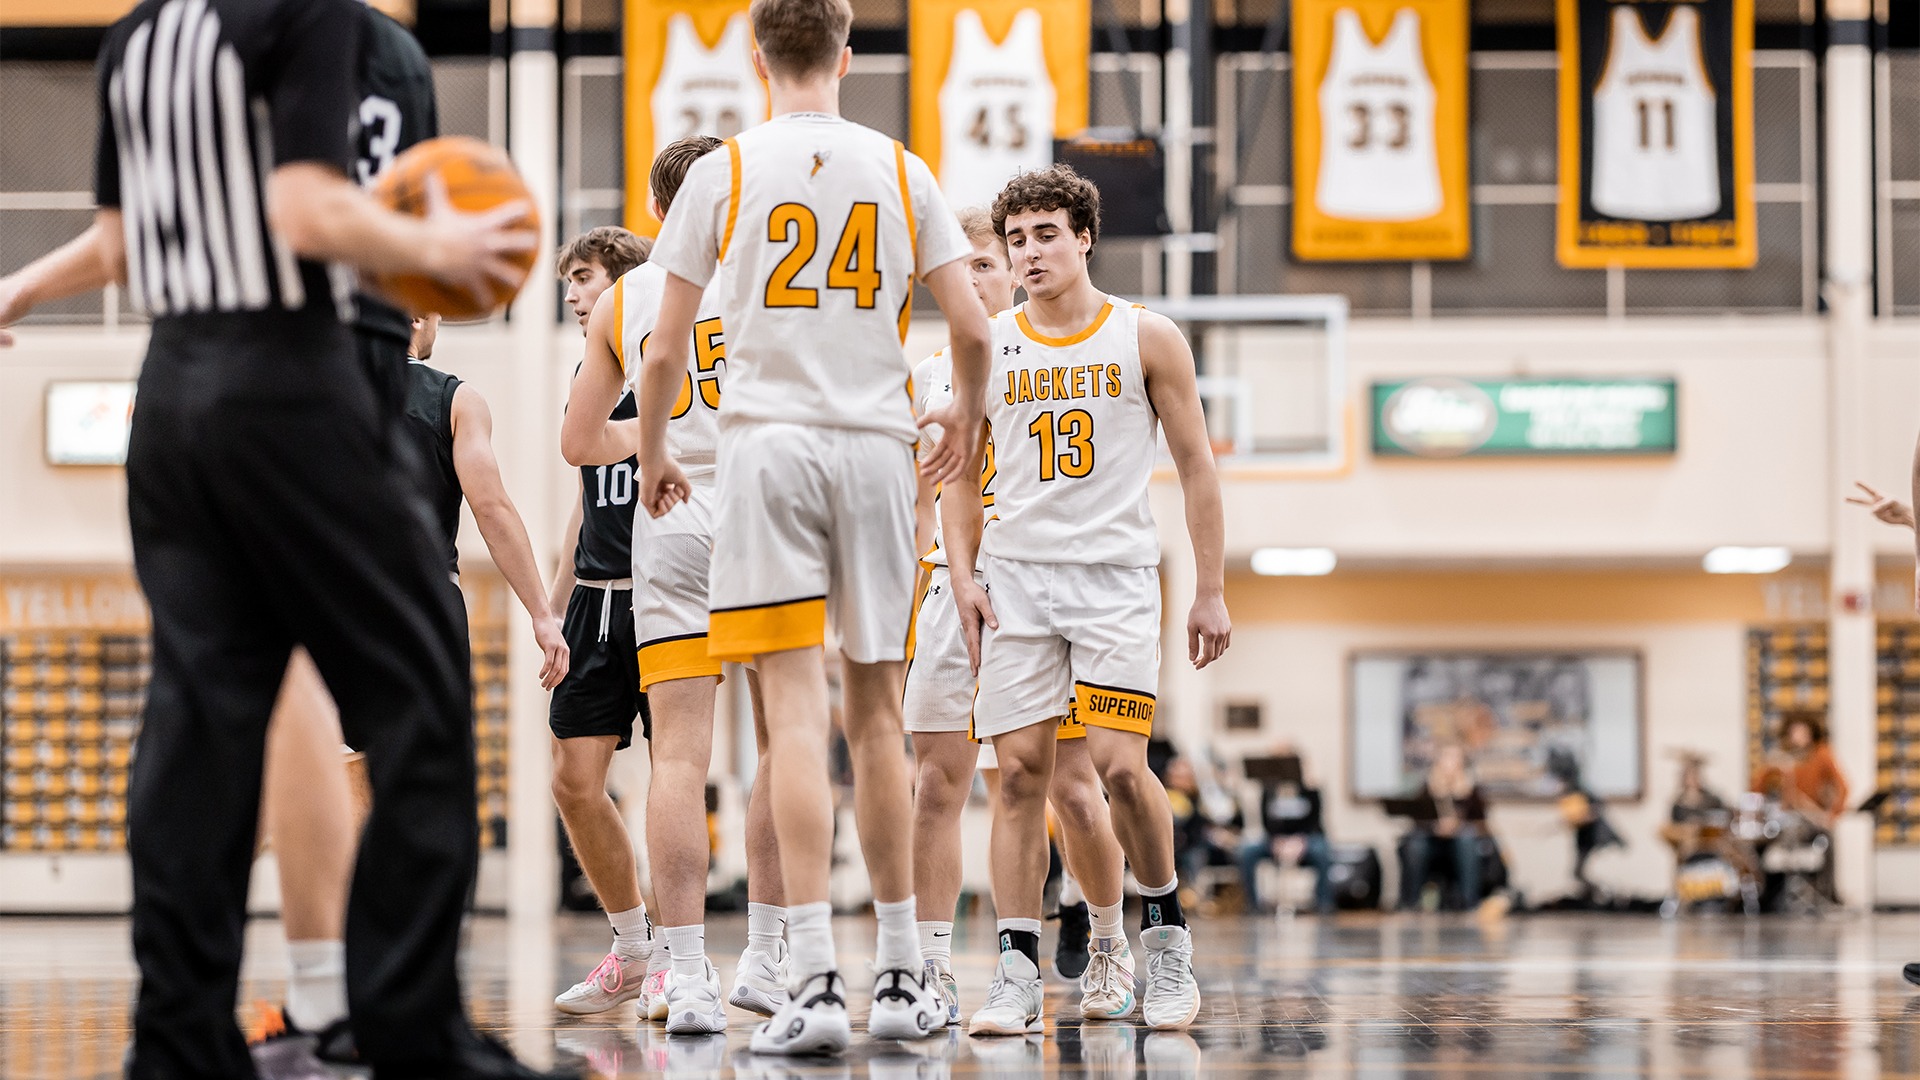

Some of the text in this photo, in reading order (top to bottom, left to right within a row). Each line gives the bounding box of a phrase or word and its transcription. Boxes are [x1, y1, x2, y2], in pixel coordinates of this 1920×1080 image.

[968, 105, 1025, 149] 45
[1347, 102, 1410, 152] 33
[1635, 98, 1676, 152] 11
[764, 202, 881, 309] 24
[1004, 363, 1121, 405] JACKETS
[1029, 408, 1095, 482] 13
[596, 463, 632, 508] 10
